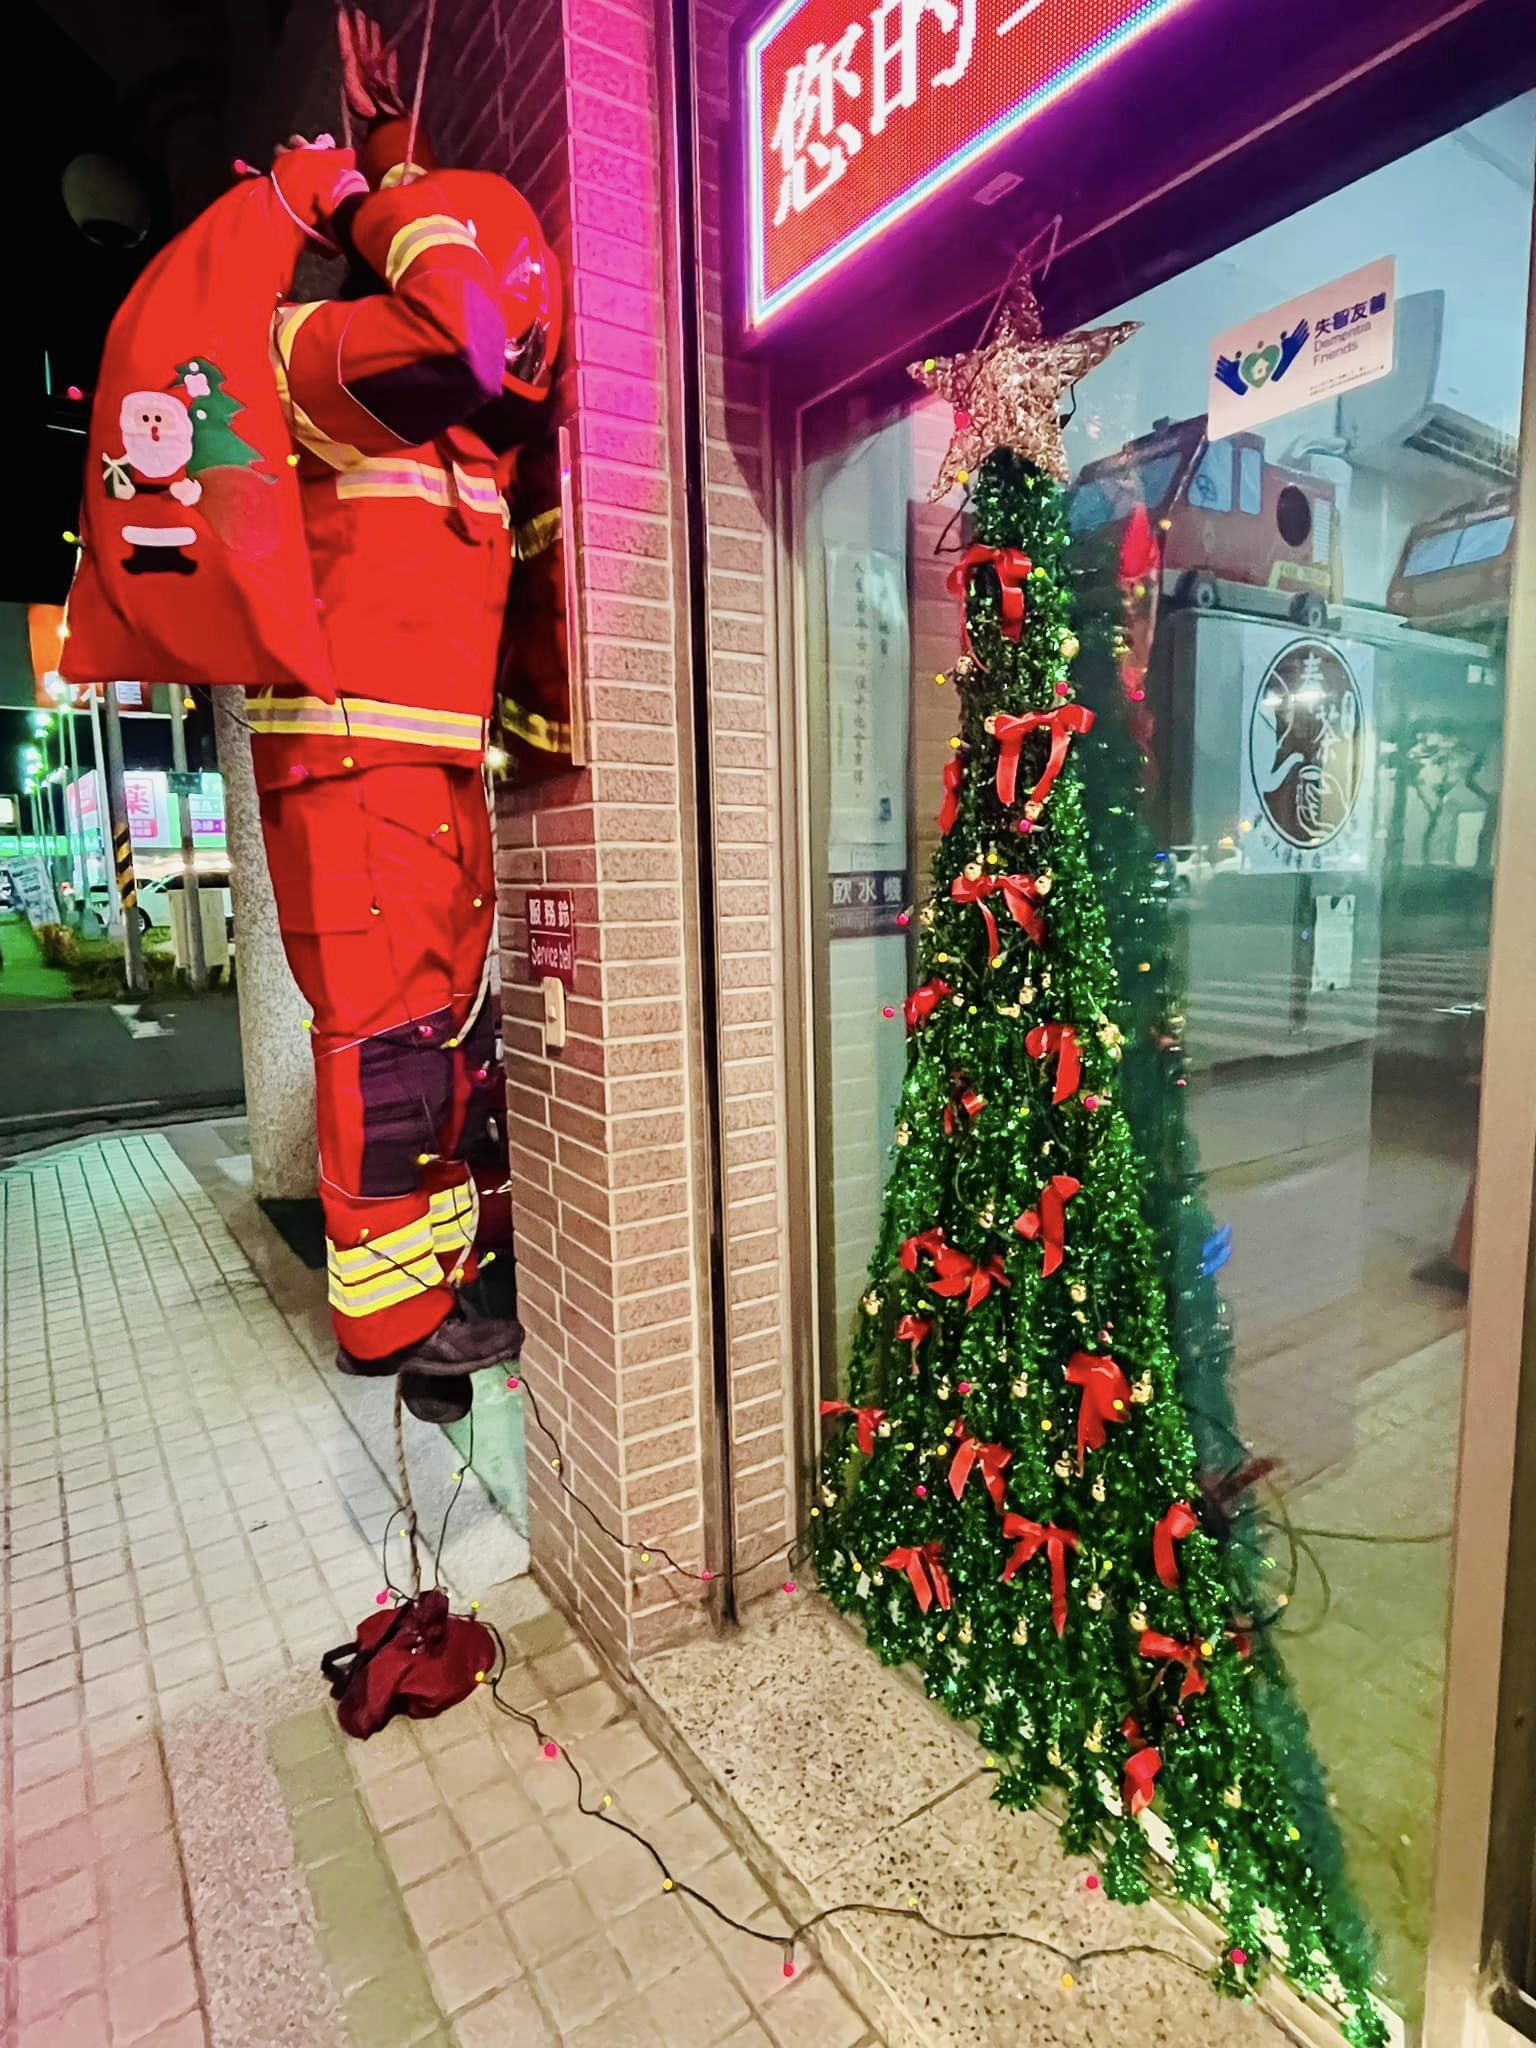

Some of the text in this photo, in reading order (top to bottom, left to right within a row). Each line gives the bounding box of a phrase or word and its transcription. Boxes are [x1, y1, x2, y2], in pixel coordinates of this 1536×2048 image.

[770, 0, 1047, 227] 您的
[1315, 291, 1386, 338] 失智友善
[1313, 321, 1372, 352] Dementia
[1313, 341, 1359, 366] Friends
[529, 898, 570, 928] 服務鈴
[531, 937, 572, 970] Service bell
